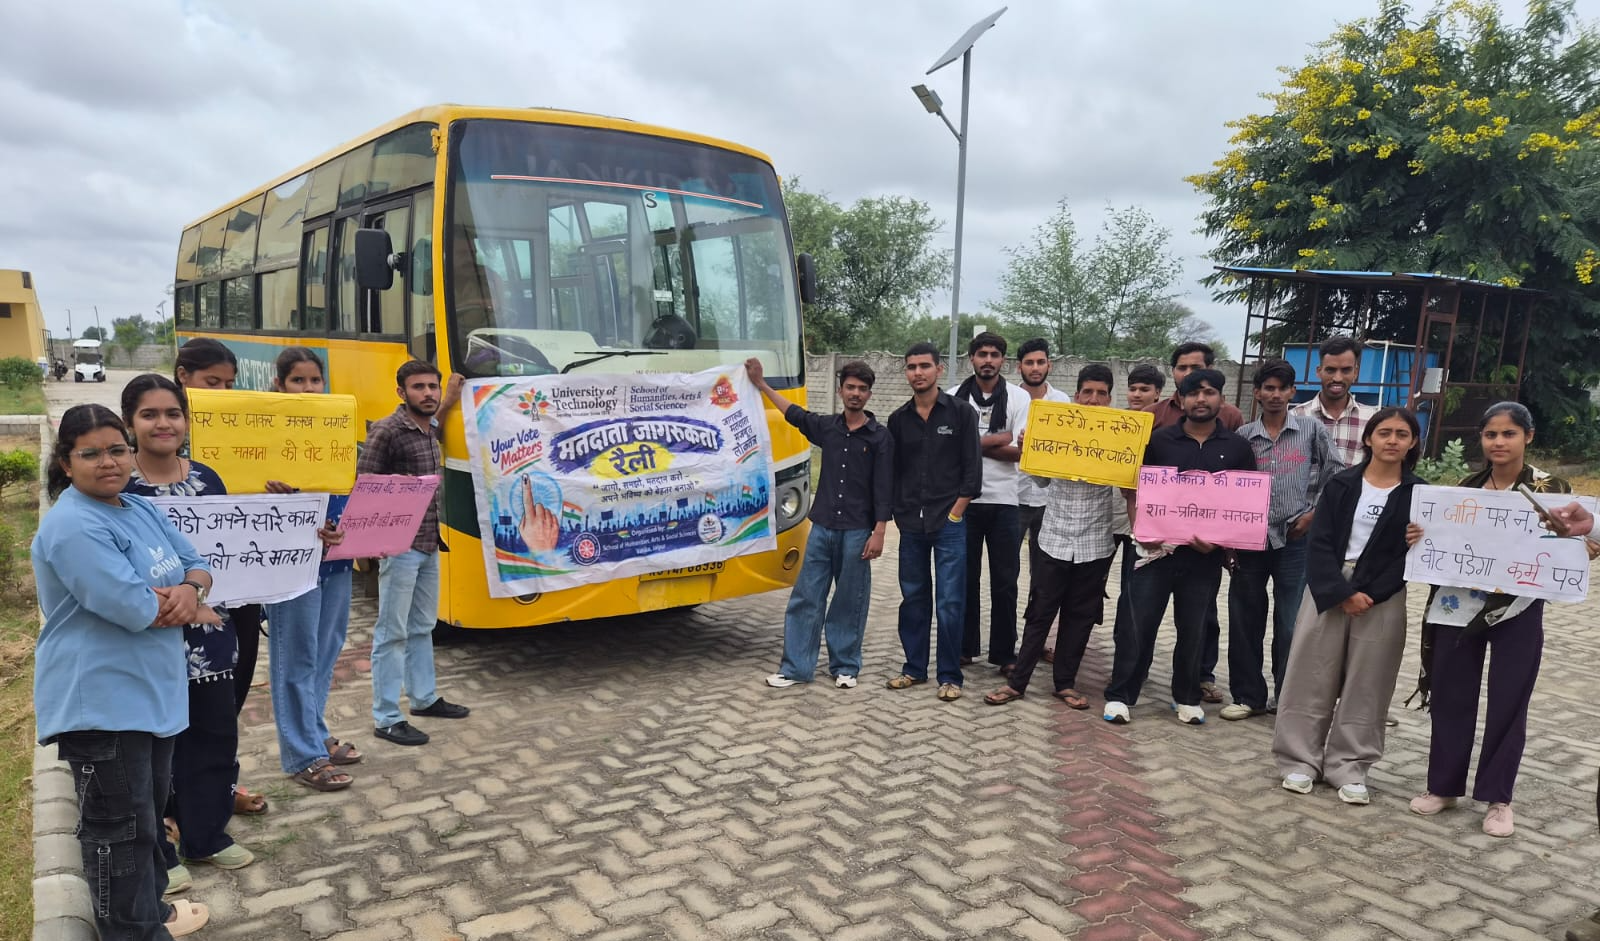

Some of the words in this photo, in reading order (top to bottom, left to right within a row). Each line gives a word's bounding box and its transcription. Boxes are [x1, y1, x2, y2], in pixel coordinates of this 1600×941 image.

[551, 386, 604, 399] University
[606, 386, 618, 396] of
[630, 386, 659, 394] School
[659, 386, 670, 394] of
[630, 393, 677, 404] Humanities,
[679, 391, 696, 401] Arts
[553, 397, 618, 411] Technology
[630, 403, 654, 413] Social
[655, 401, 688, 411] Sciences
[1038, 414, 1054, 425] न
[1095, 420, 1108, 432] न
[281, 439, 299, 462] को
[303, 439, 324, 462] वोट
[491, 438, 515, 464] Your
[516, 428, 540, 444] Vote
[558, 422, 628, 461] मतदाता
[1030, 438, 1072, 456] मतदान
[1072, 440, 1083, 457] के
[501, 440, 543, 471] Matters
[609, 443, 656, 476] रैली
[207, 506, 250, 531] अपने
[251, 506, 287, 533] सारे
[1222, 509, 1264, 524] मतदान
[1421, 501, 1437, 523] न
[1443, 498, 1483, 526] जाति
[1485, 507, 1513, 529] पर
[268, 548, 315, 567] मतदान
[1420, 538, 1448, 572] वोट
[1506, 552, 1551, 583] कर्म
[1552, 566, 1585, 592] पर
